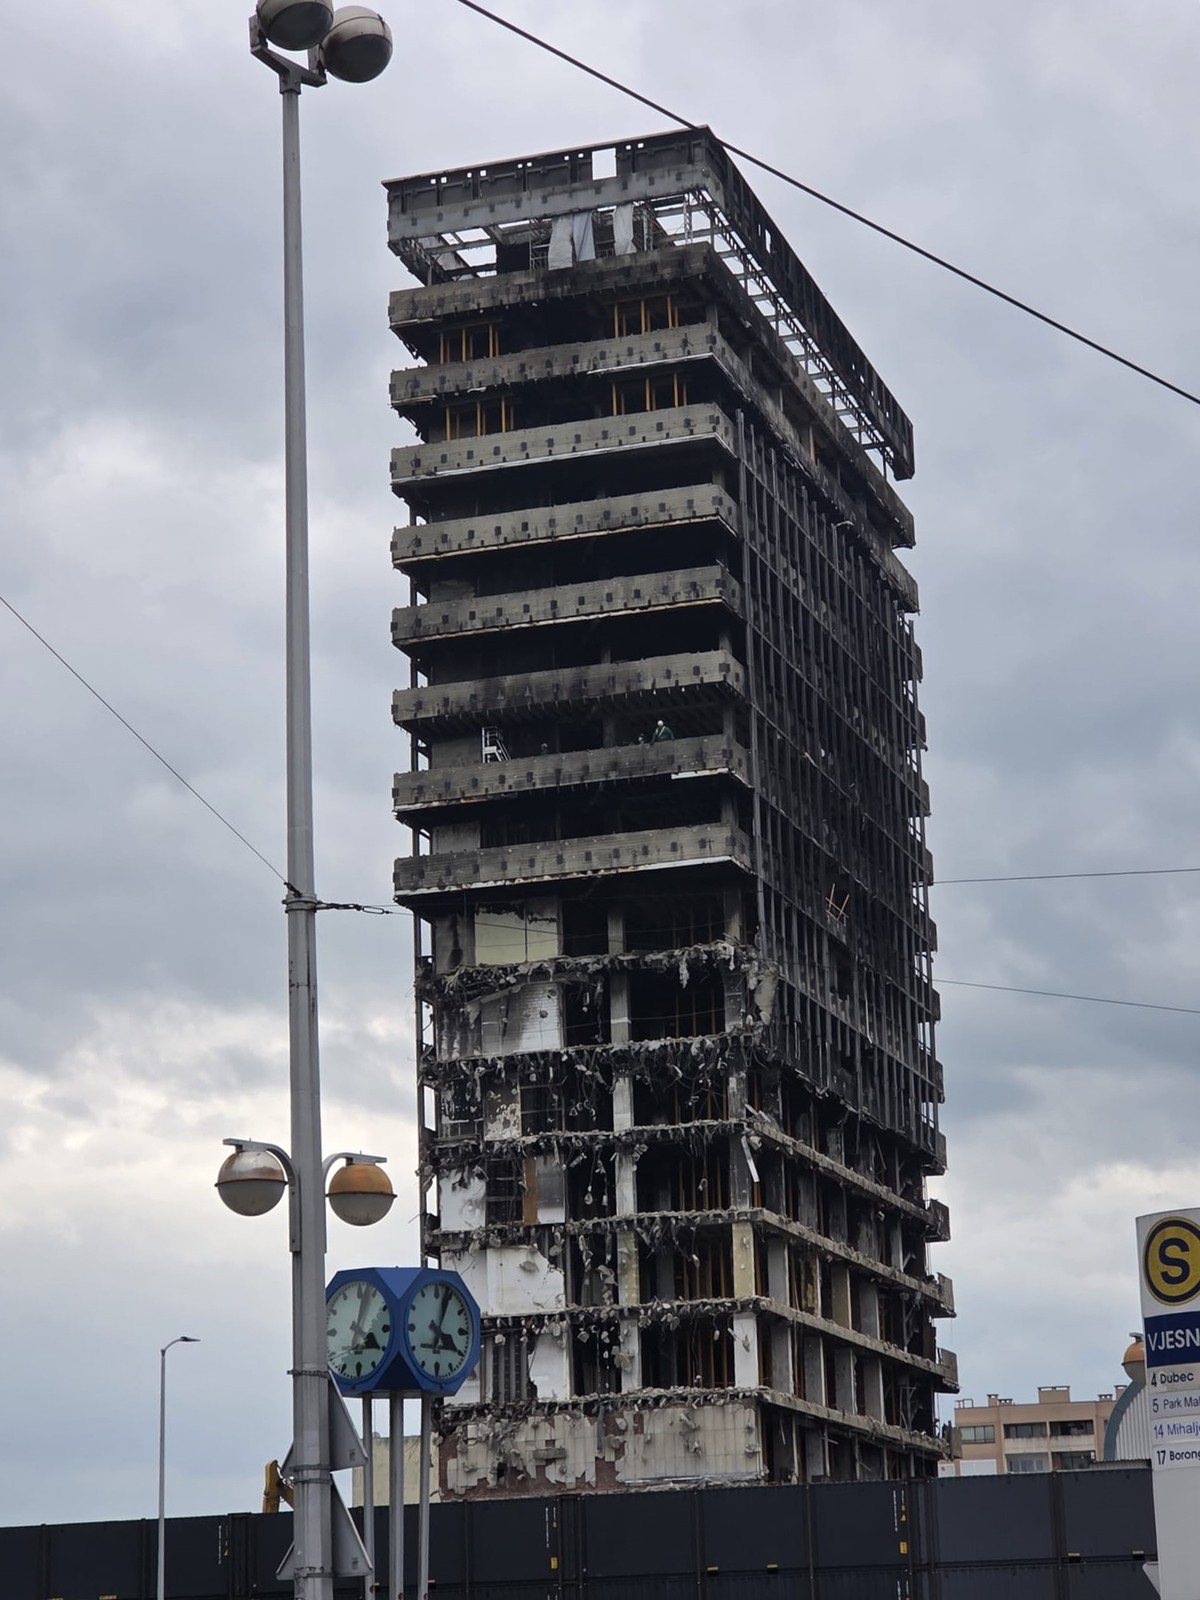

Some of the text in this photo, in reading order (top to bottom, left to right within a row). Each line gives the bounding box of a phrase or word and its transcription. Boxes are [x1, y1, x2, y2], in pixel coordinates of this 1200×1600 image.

[1158, 1237, 1190, 1285] S
[1147, 1327, 1200, 1351] VJESN
[1151, 1372, 1194, 1387] 4 Dubec
[1152, 1396, 1200, 1413] 5 Park Ma
[1153, 1421, 1200, 1438] 14 Mihalj
[1157, 1450, 1166, 1465] 17
